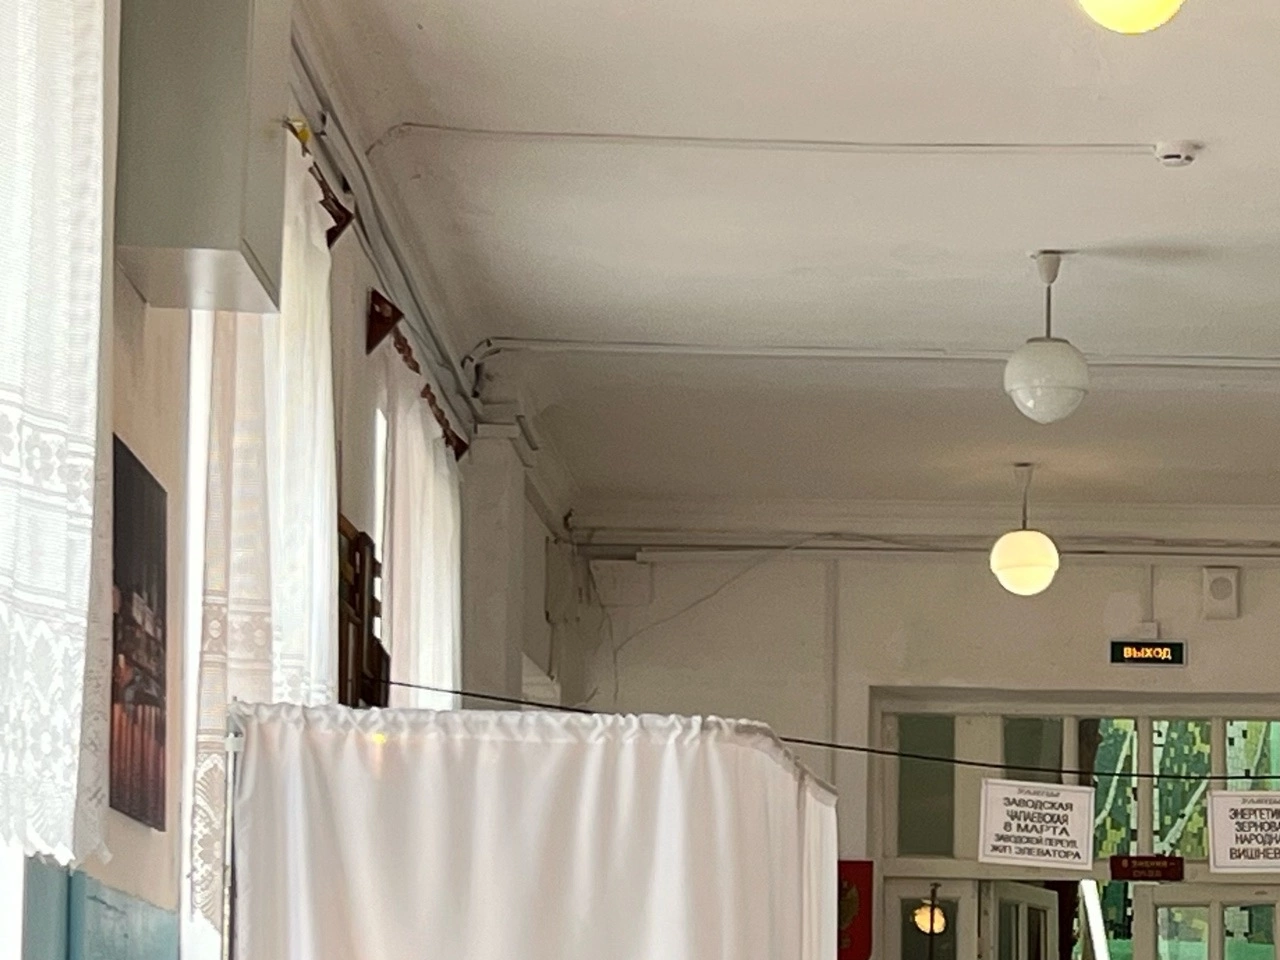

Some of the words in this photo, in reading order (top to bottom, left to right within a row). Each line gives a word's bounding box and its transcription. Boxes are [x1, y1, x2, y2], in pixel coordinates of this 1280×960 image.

[1123, 647, 1172, 660] ВЫХОД
[1003, 797, 1073, 812] ЗАВОДСКАЯ
[1003, 821, 1012, 833] 8
[1017, 823, 1070, 837] МАРТА
[1015, 846, 1081, 860] ЭЛЕВАТОРА
